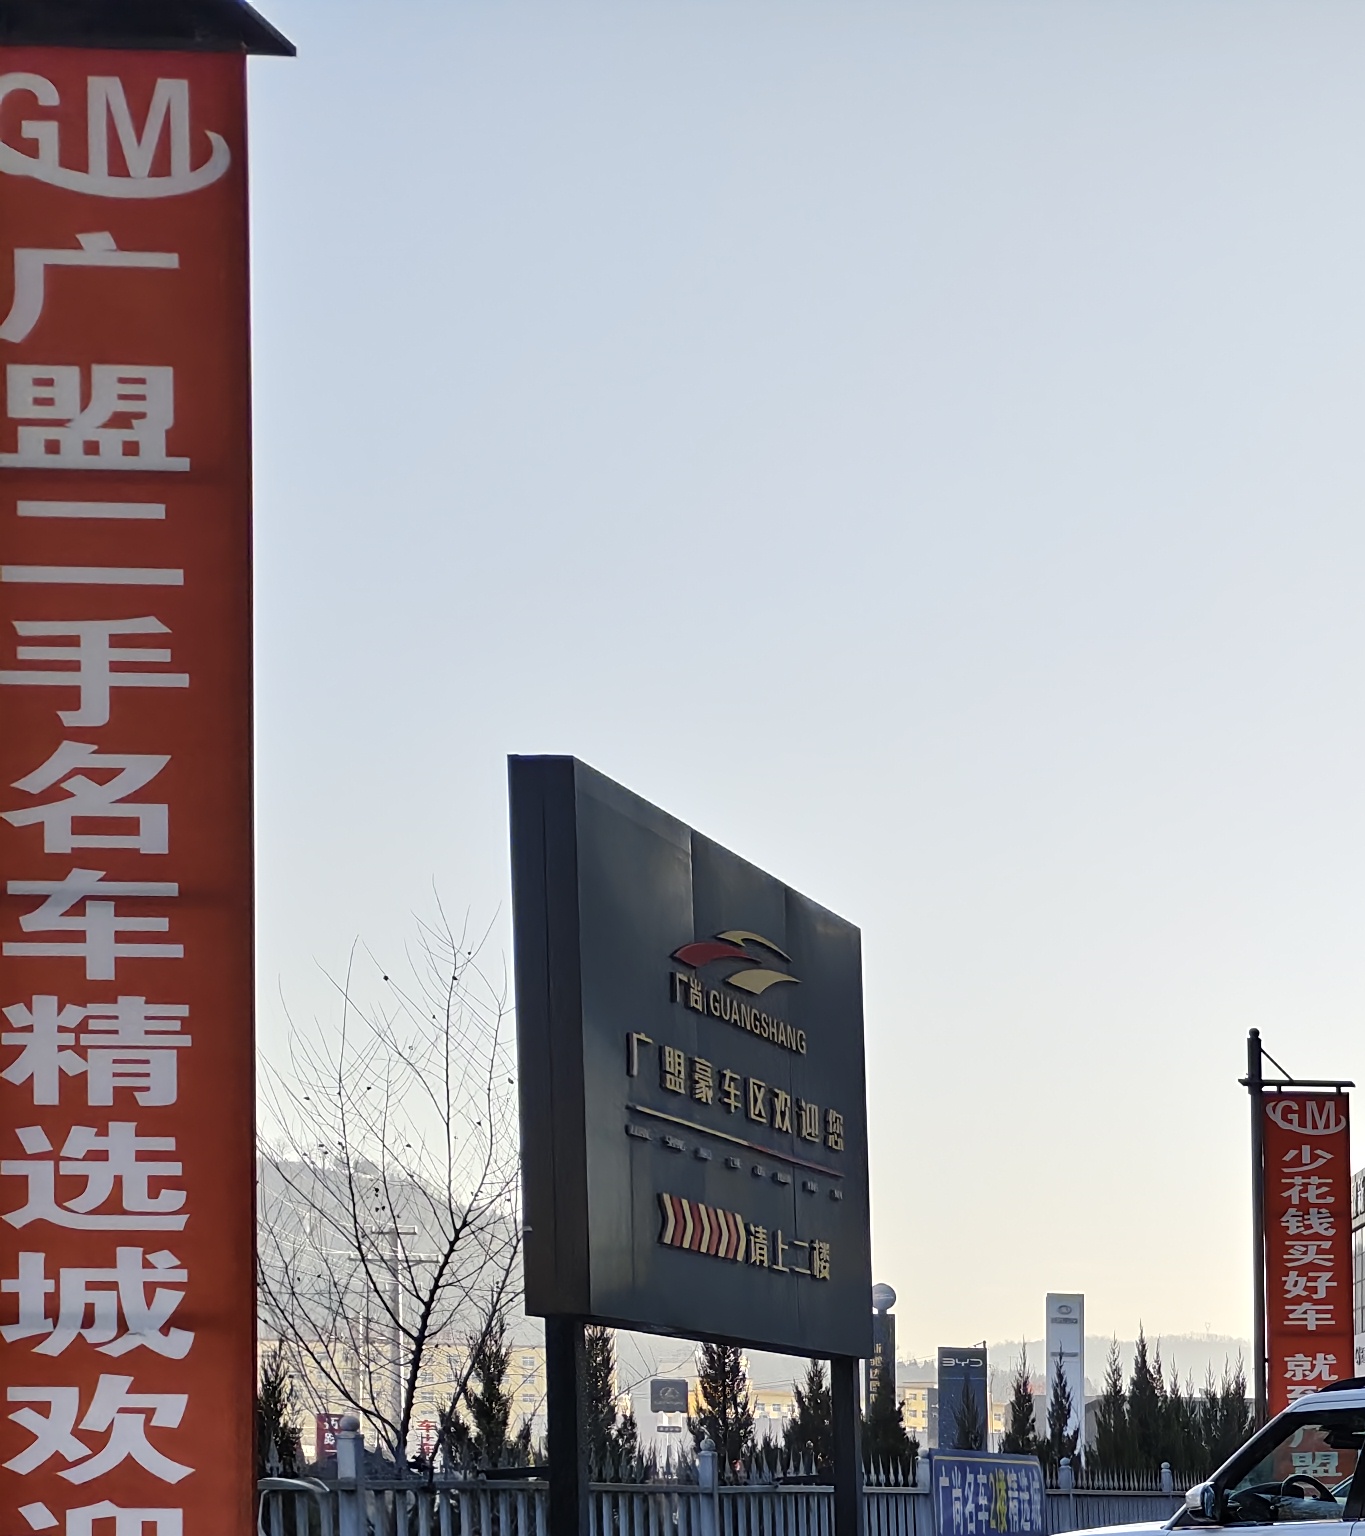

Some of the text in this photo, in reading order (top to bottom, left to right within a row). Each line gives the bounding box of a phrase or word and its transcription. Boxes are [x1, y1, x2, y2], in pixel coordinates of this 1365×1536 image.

[0, 73, 208, 186] GM
[710, 990, 807, 1055] GUANGSHANG
[630, 1032, 845, 1151] 广盟豪车区欢迎您
[1270, 1100, 1343, 1134] GM
[749, 1223, 830, 1281] 请上二楼
[1281, 1145, 1337, 1331] 少花钱买好车
[942, 1357, 984, 1368] BYD
